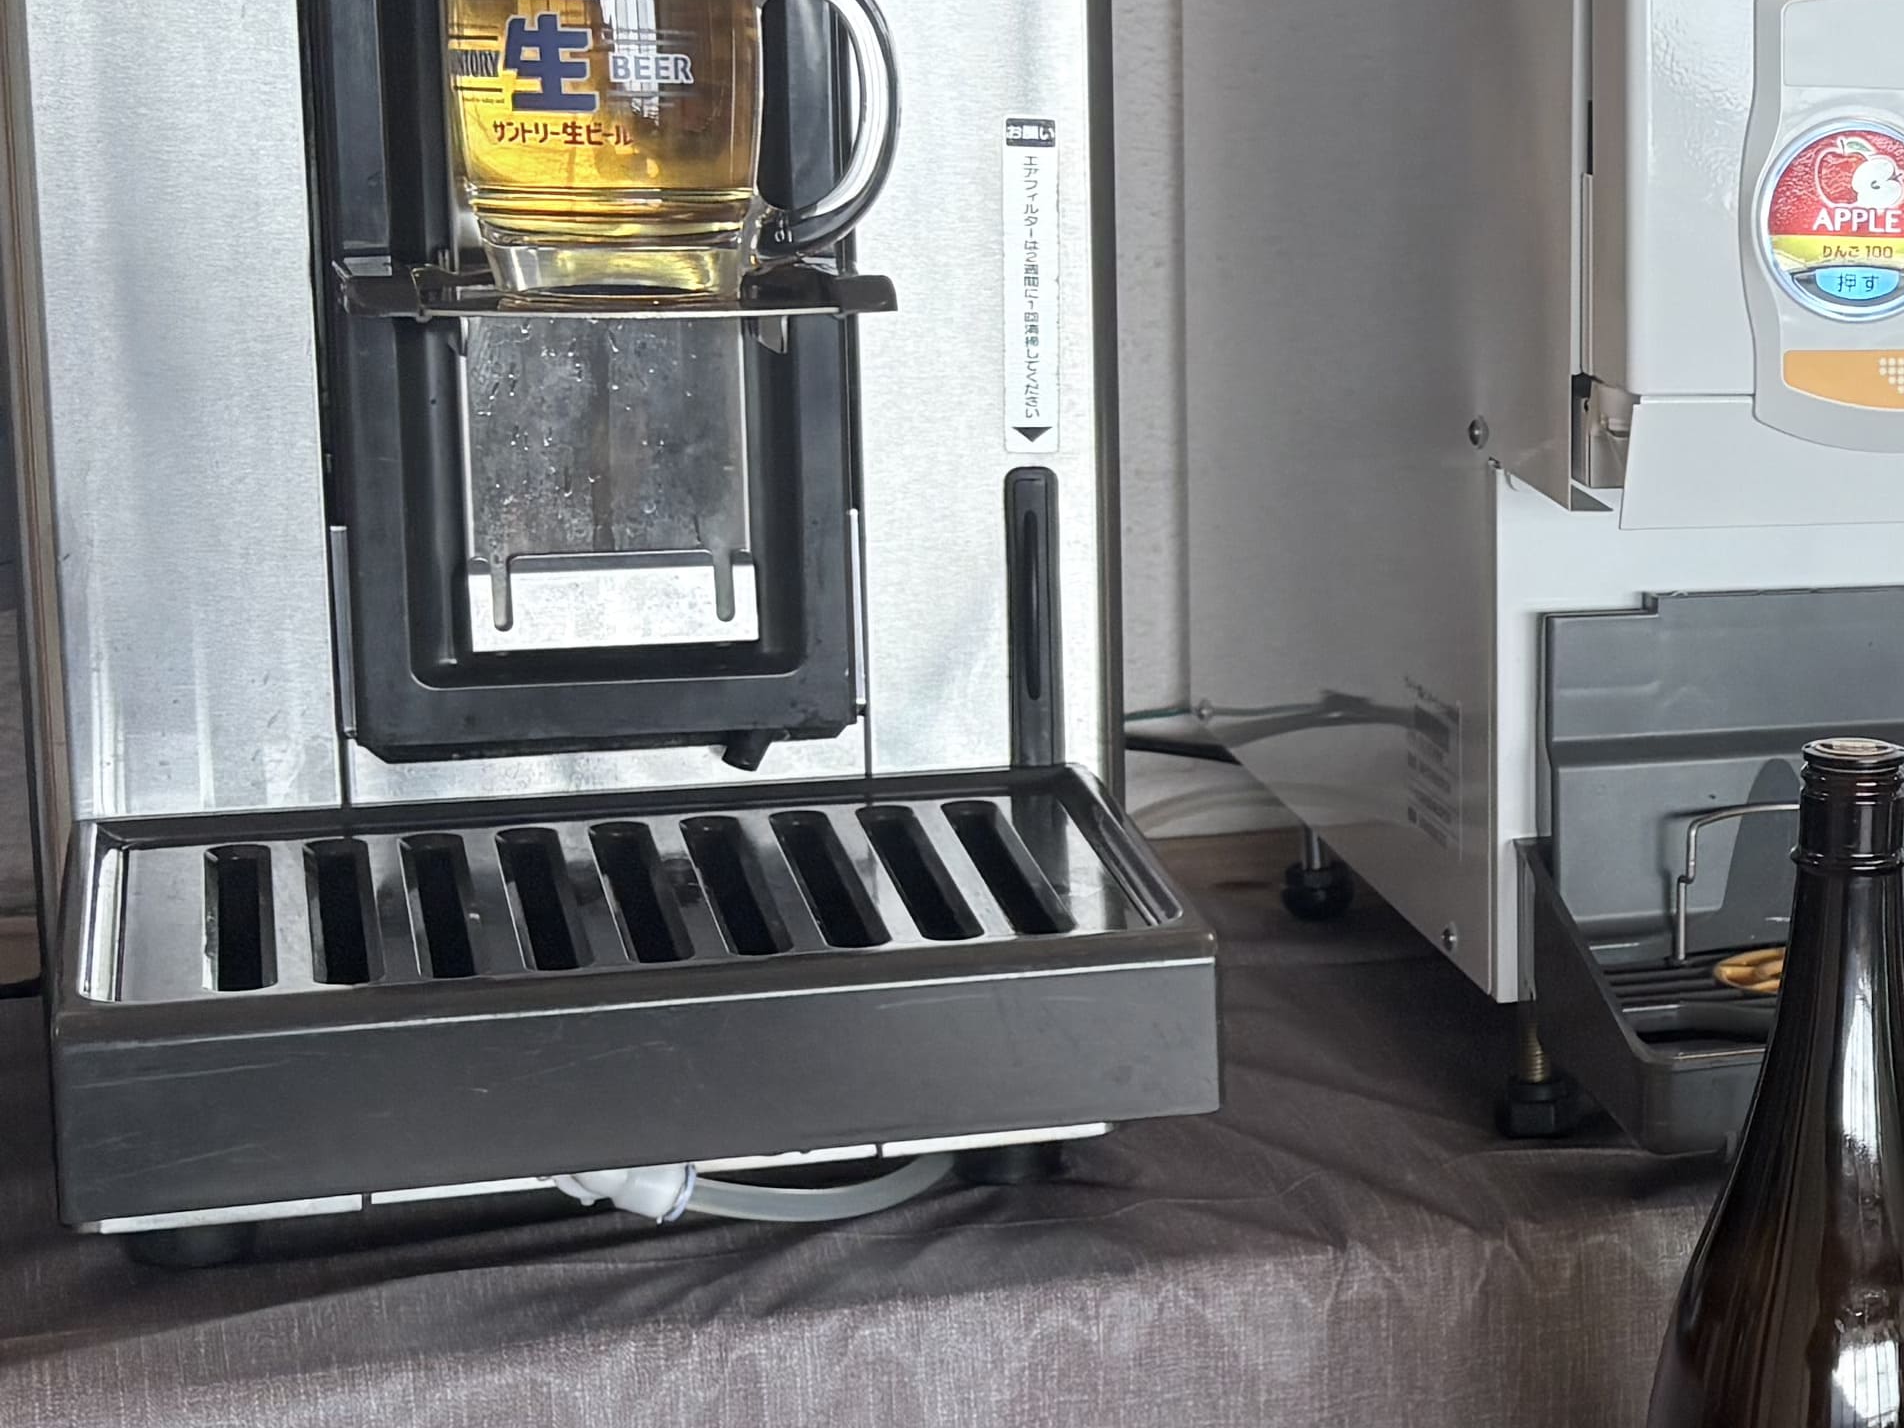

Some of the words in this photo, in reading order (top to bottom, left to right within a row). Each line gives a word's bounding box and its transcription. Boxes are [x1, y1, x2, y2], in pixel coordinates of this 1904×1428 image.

[504, 13, 600, 112] 生
[610, 53, 694, 83] BEER
[493, 120, 634, 147] サントリー生ビール
[1812, 208, 1902, 234] APPLE
[1821, 242, 1861, 260] りんご
[1864, 243, 1894, 260] 100
[1837, 273, 1881, 293] 押す
